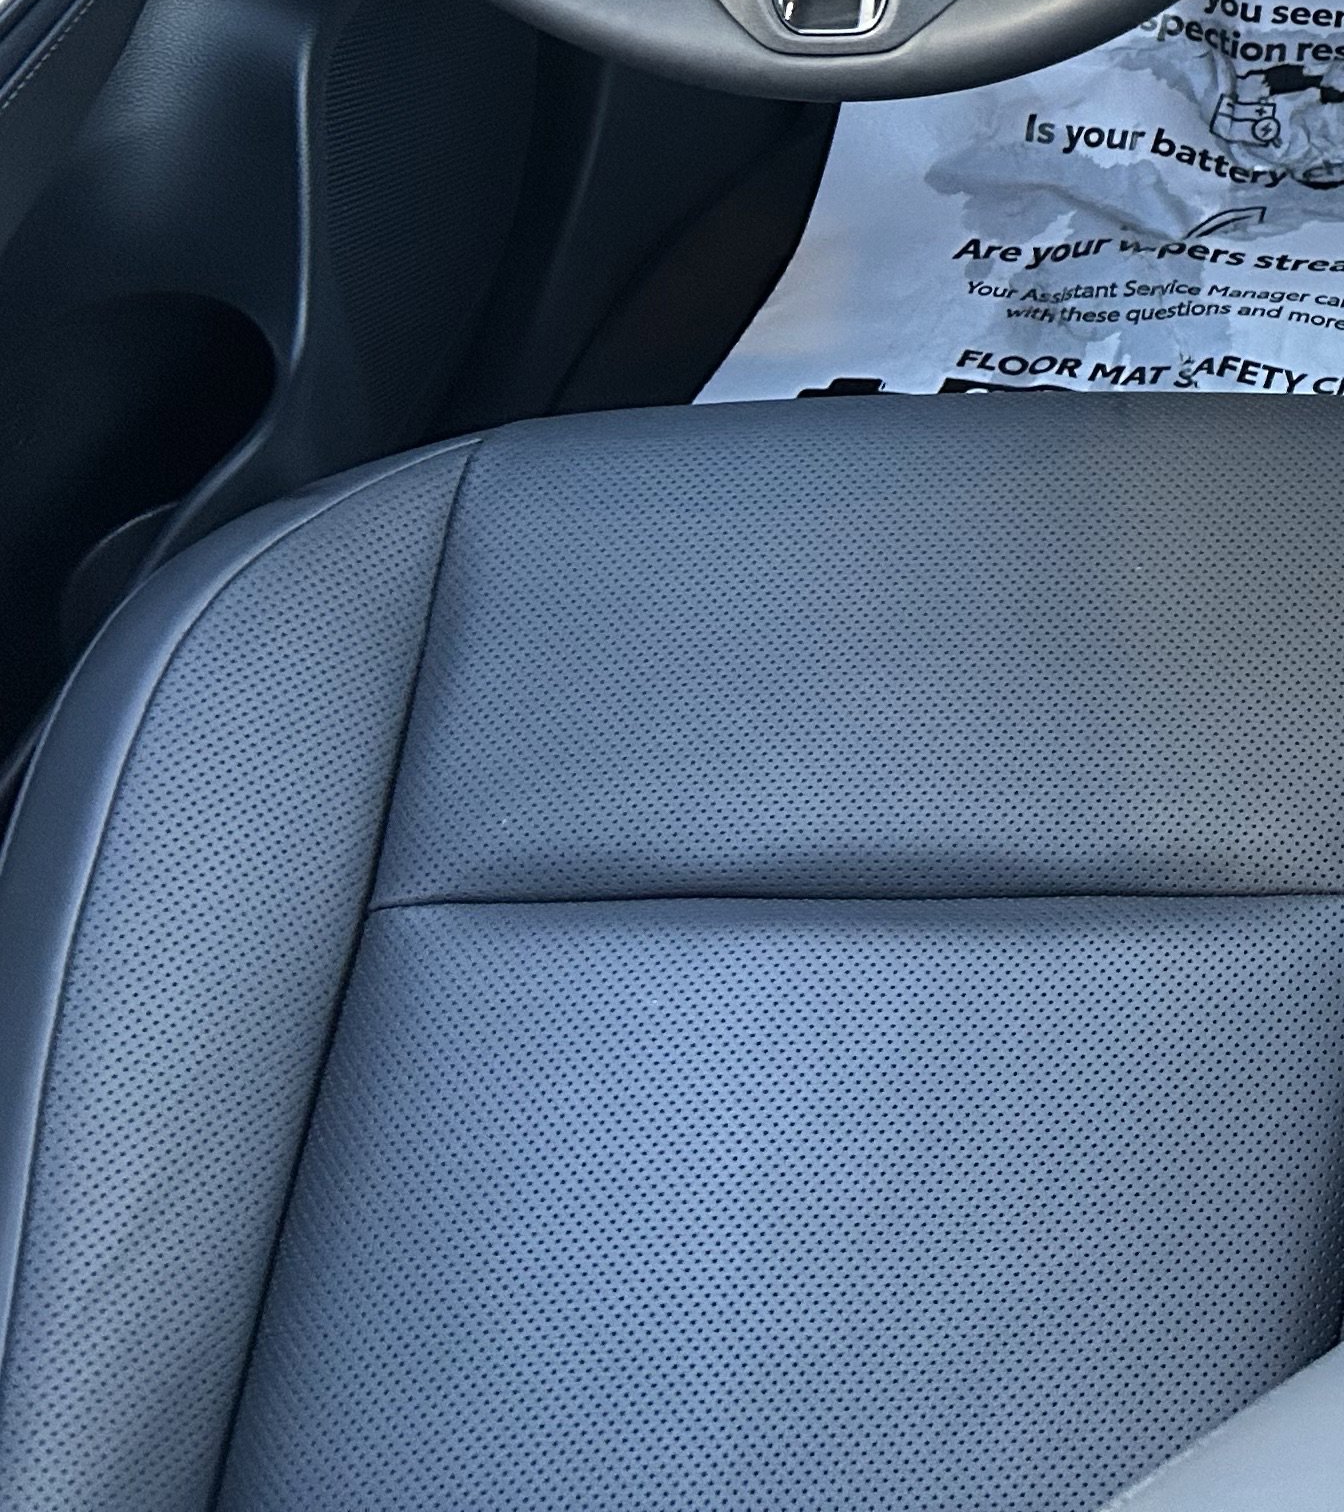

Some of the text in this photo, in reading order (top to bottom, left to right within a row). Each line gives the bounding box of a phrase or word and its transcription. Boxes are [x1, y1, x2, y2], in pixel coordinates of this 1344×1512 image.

[1139, 13, 1287, 63] spection
[1024, 113, 1055, 145] Is
[1062, 122, 1145, 155] your
[1150, 127, 1288, 189] battery
[952, 238, 1023, 263] Are
[1030, 237, 1113, 270] your
[1119, 238, 1247, 266] wpers
[967, 280, 1019, 299] Your
[1020, 281, 1118, 305] Assistant
[1123, 278, 1201, 298] Service
[1207, 284, 1311, 303] Manager
[1006, 305, 1056, 324] with
[1060, 306, 1121, 324] these
[1126, 300, 1231, 326] questions
[1237, 305, 1284, 320] and
[955, 348, 1083, 379] FLOOR
[1088, 363, 1171, 386] MAT
